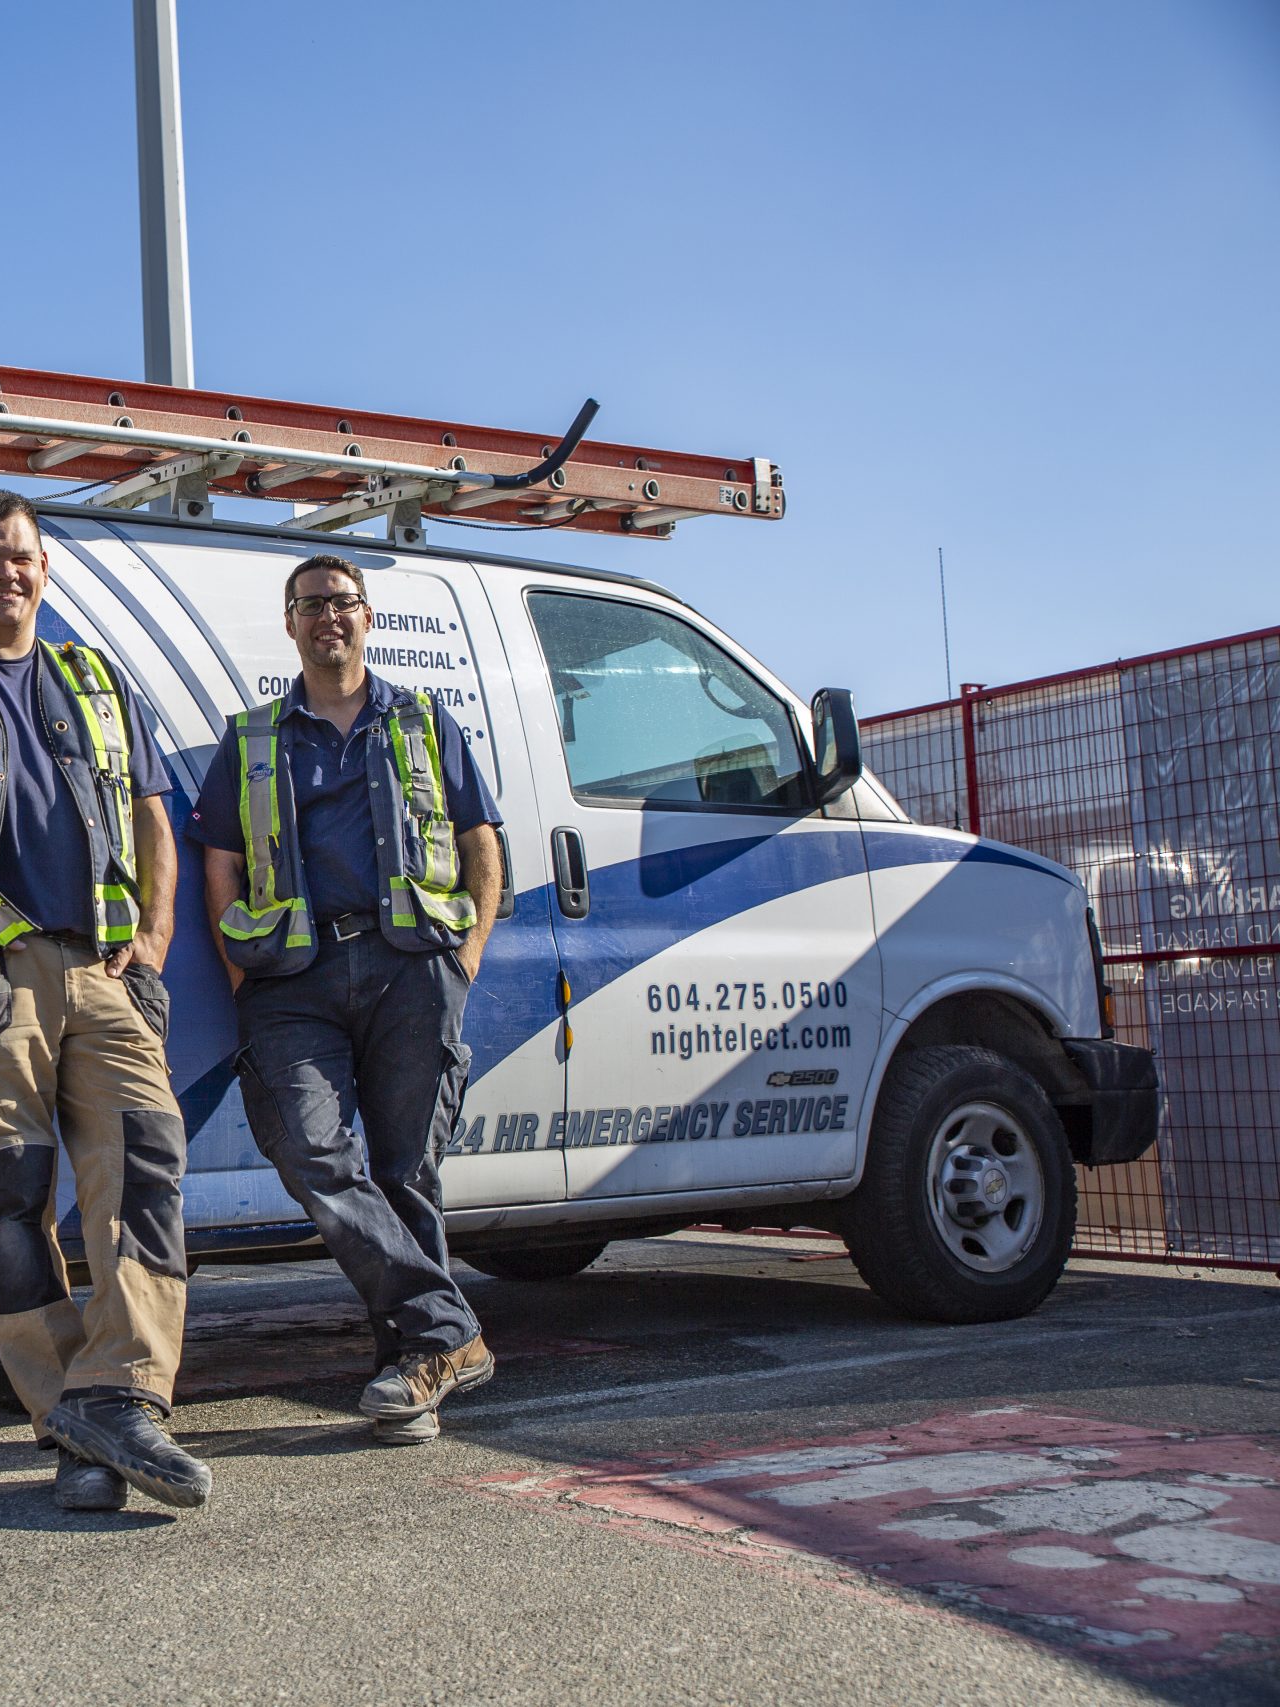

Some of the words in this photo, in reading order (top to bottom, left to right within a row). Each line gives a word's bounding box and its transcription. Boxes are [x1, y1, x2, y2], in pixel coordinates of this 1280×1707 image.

[372, 612, 445, 635] IDENTIAL
[362, 646, 456, 671] MMERCIAL
[647, 981, 848, 1012] 604.275.0500
[651, 1022, 851, 1060] nightelect.com
[790, 1070, 838, 1085] 2500
[447, 1114, 487, 1154] 24
[492, 1112, 540, 1151] HR
[546, 1101, 729, 1150] EMERGENCY
[733, 1095, 850, 1138] SERVICE
